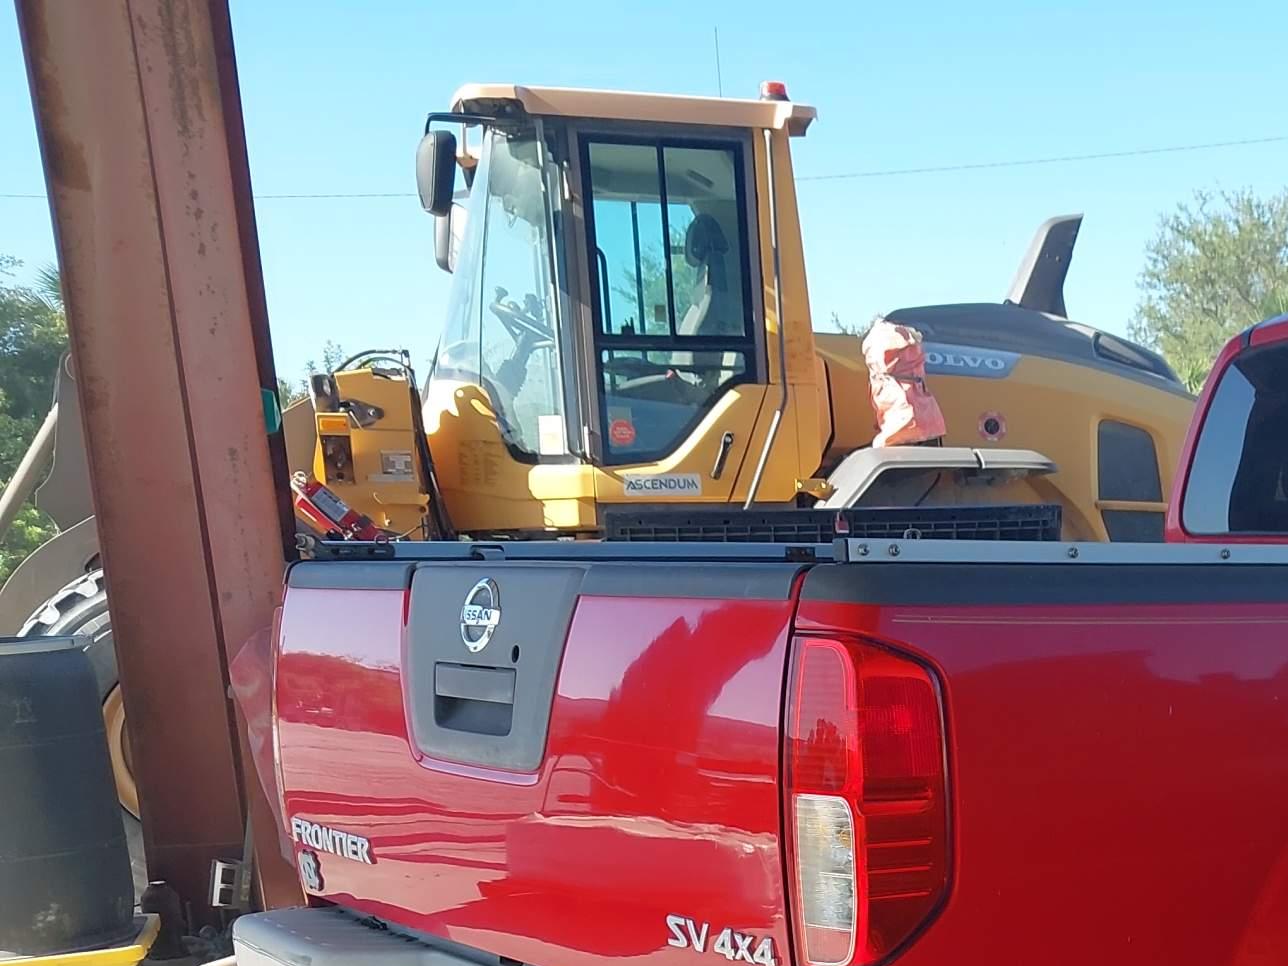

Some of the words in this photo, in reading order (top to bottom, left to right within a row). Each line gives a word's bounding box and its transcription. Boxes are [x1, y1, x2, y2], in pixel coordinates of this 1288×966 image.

[924, 351, 1006, 371] OLVO
[626, 478, 699, 491] ASCENDUM
[290, 816, 374, 865] FRONTIER
[665, 914, 709, 953] SV
